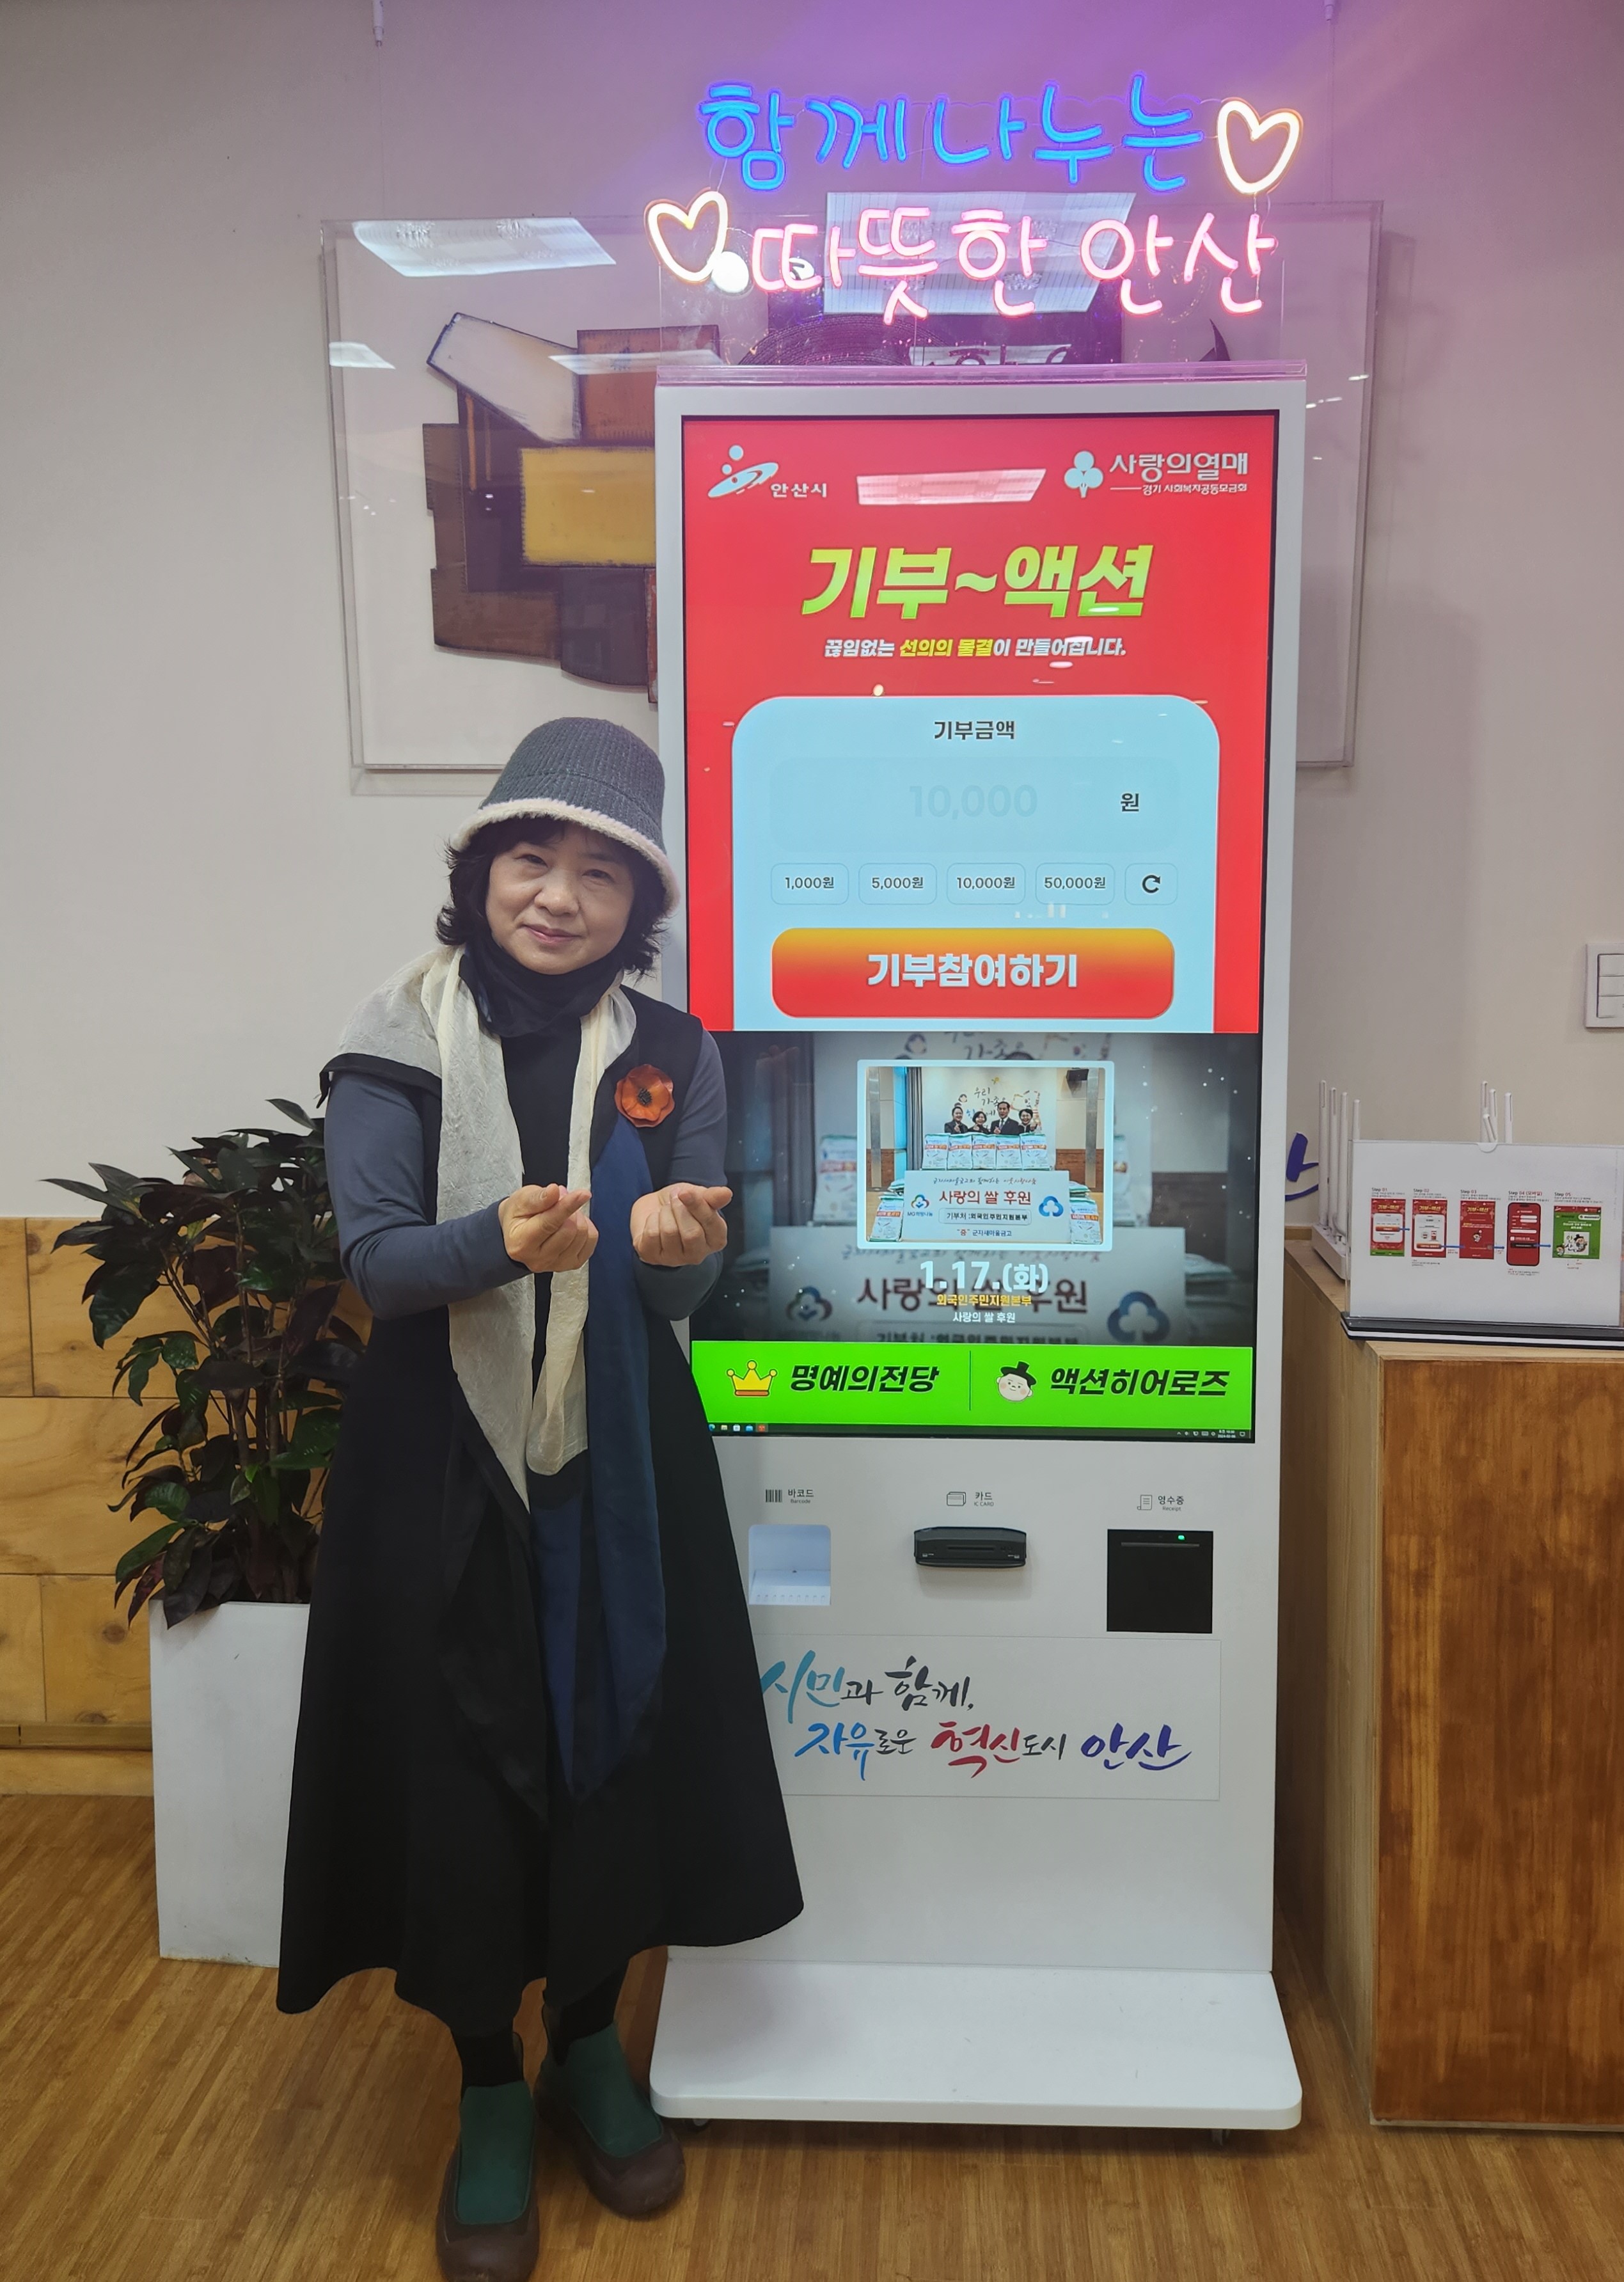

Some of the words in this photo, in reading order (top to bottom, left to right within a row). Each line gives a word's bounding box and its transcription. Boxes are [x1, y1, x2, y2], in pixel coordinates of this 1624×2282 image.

[699, 82, 907, 191] 함께
[932, 74, 1204, 193] 나누는
[752, 206, 1049, 325] 따뜻한
[1080, 212, 1278, 315] 안산
[1109, 452, 1249, 483] 사랑의열매
[770, 482, 828, 498] 안산시
[1142, 484, 1162, 496] 경기
[1163, 482, 1247, 495] 사회복지공동모금회
[801, 544, 1154, 619] 기부~액션
[824, 638, 895, 658] 끊임없는
[899, 638, 954, 658] 선의의
[958, 638, 1012, 658] 물결이
[1014, 638, 1126, 658] 만들어집니다.
[933, 720, 1016, 741] 기부금액
[910, 783, 1039, 821] 10,000
[1120, 792, 1140, 814] 원
[785, 876, 835, 890] 1,000원
[871, 876, 924, 890] 5,000원
[957, 876, 1016, 890] 10,000원
[1044, 876, 1107, 890] 50,000원
[867, 953, 1078, 988] 기부참여하기
[939, 1190, 981, 1205] 사랑의
[984, 1190, 999, 1205] 쌀
[1003, 1190, 1032, 1206] 후원
[920, 1260, 1049, 1293] 1.17.(화)
[936, 1294, 1032, 1307] 외국인주민지원본부
[952, 1311, 982, 1323] 사랑의
[984, 1311, 994, 1322] 쌀
[997, 1311, 1016, 1323] 후원
[789, 1363, 940, 1394] 명예의전당
[1050, 1367, 1231, 1398] 액션히어로즈
[787, 1488, 814, 1498] 바코드
[975, 1491, 993, 1501] 카드
[761, 1649, 884, 1724] 시민과
[885, 1655, 974, 1711] 함께,
[794, 1722, 917, 1781] 자유로운
[930, 1721, 1067, 1779] 혁신도시
[1080, 1722, 1192, 1770] 안산
